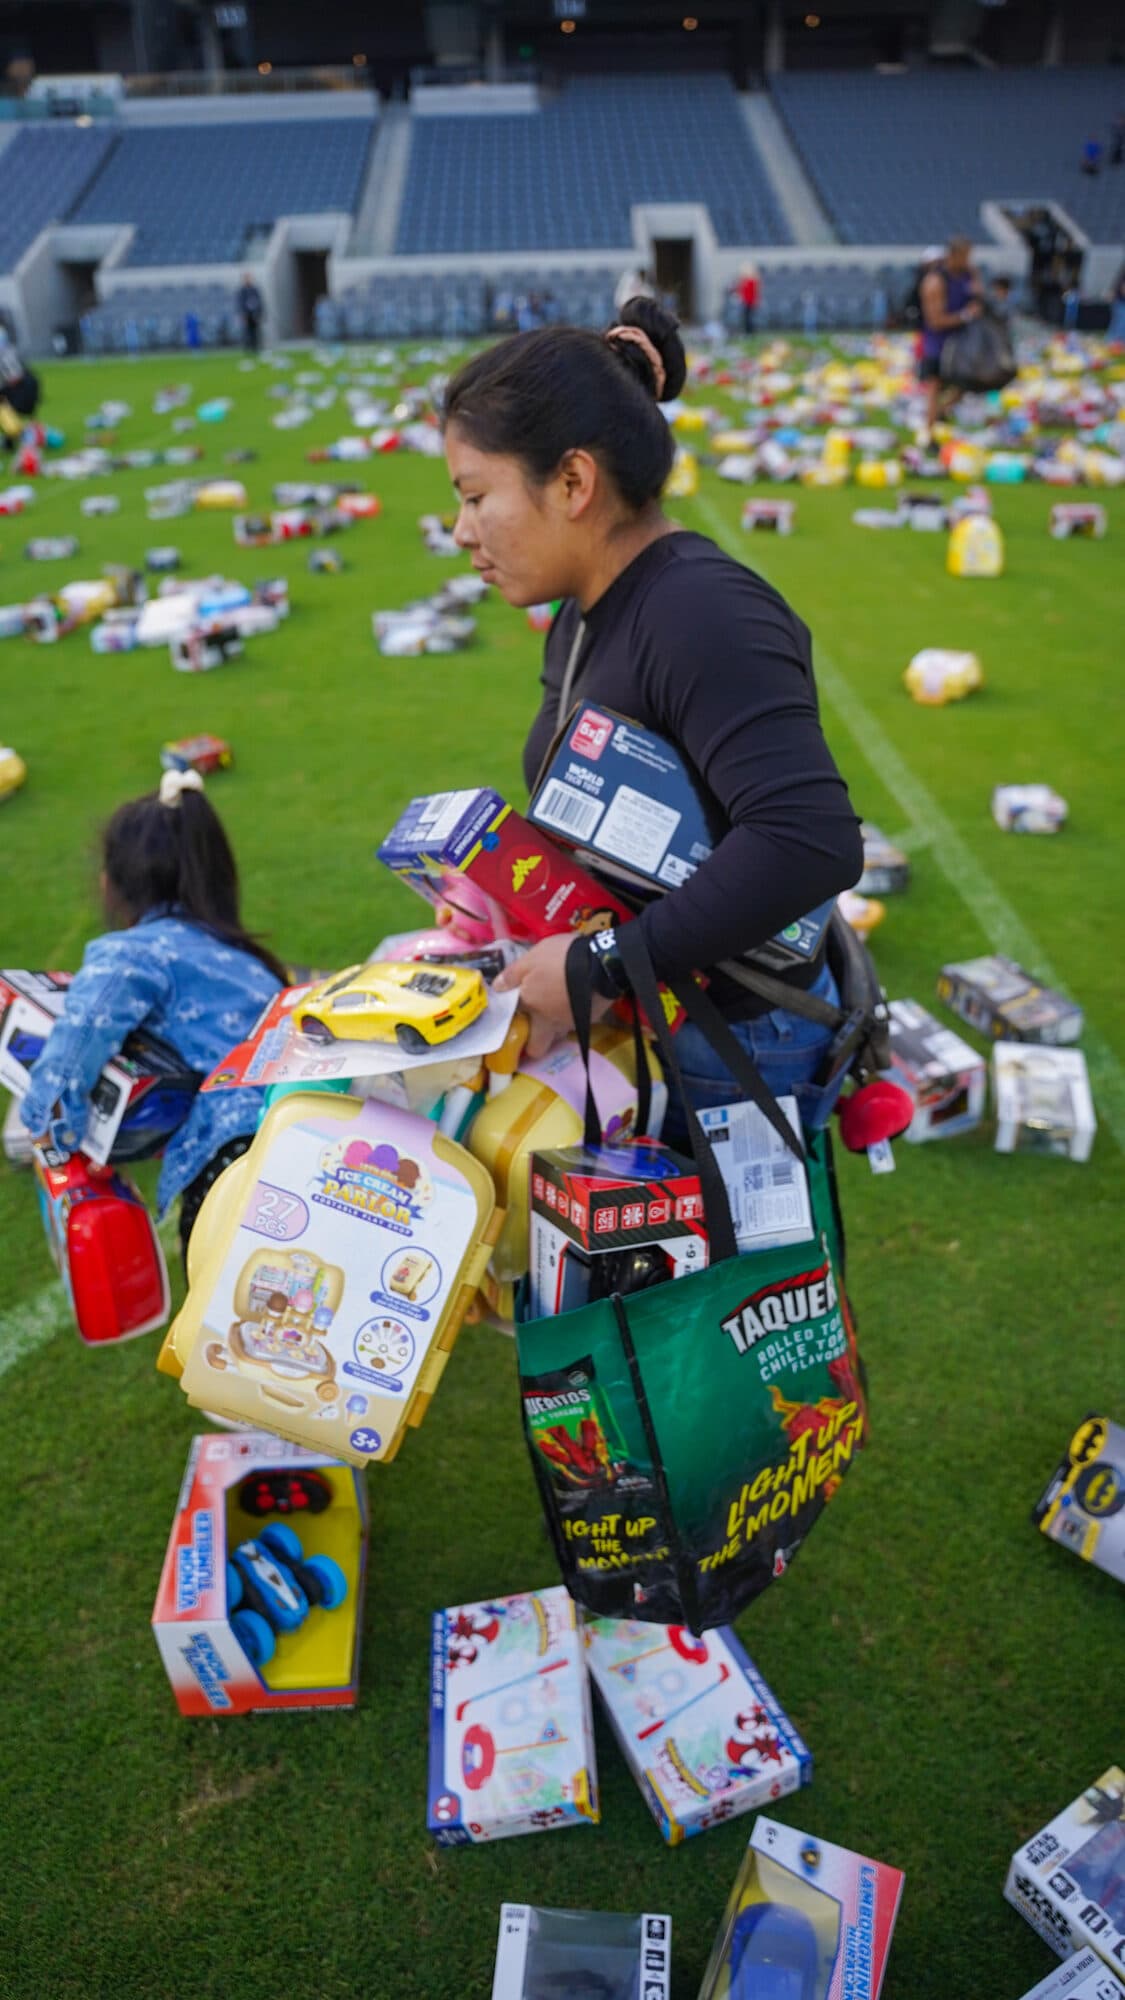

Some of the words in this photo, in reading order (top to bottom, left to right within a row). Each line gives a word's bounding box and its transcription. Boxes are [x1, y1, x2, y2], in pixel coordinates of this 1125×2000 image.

[322, 1179, 411, 1226] PARLOR
[338, 1170, 361, 1185] ICE
[363, 1176, 411, 1206] CREAM
[257, 1191, 299, 1220] 27
[362, 1212, 385, 1227] PLAY
[255, 1215, 287, 1237] PCS
[687, 1243, 697, 1259] 6+
[757, 1328, 814, 1365] ROLLED
[760, 1343, 807, 1382] CHILE
[351, 1431, 378, 1449] 3+
[727, 1428, 813, 1538] LIGHT
[817, 1401, 858, 1449] UP
[697, 1534, 741, 1573] THE
[746, 1415, 863, 1541] MOMENT
[625, 1517, 656, 1537] UP
[592, 1539, 621, 1553] THE
